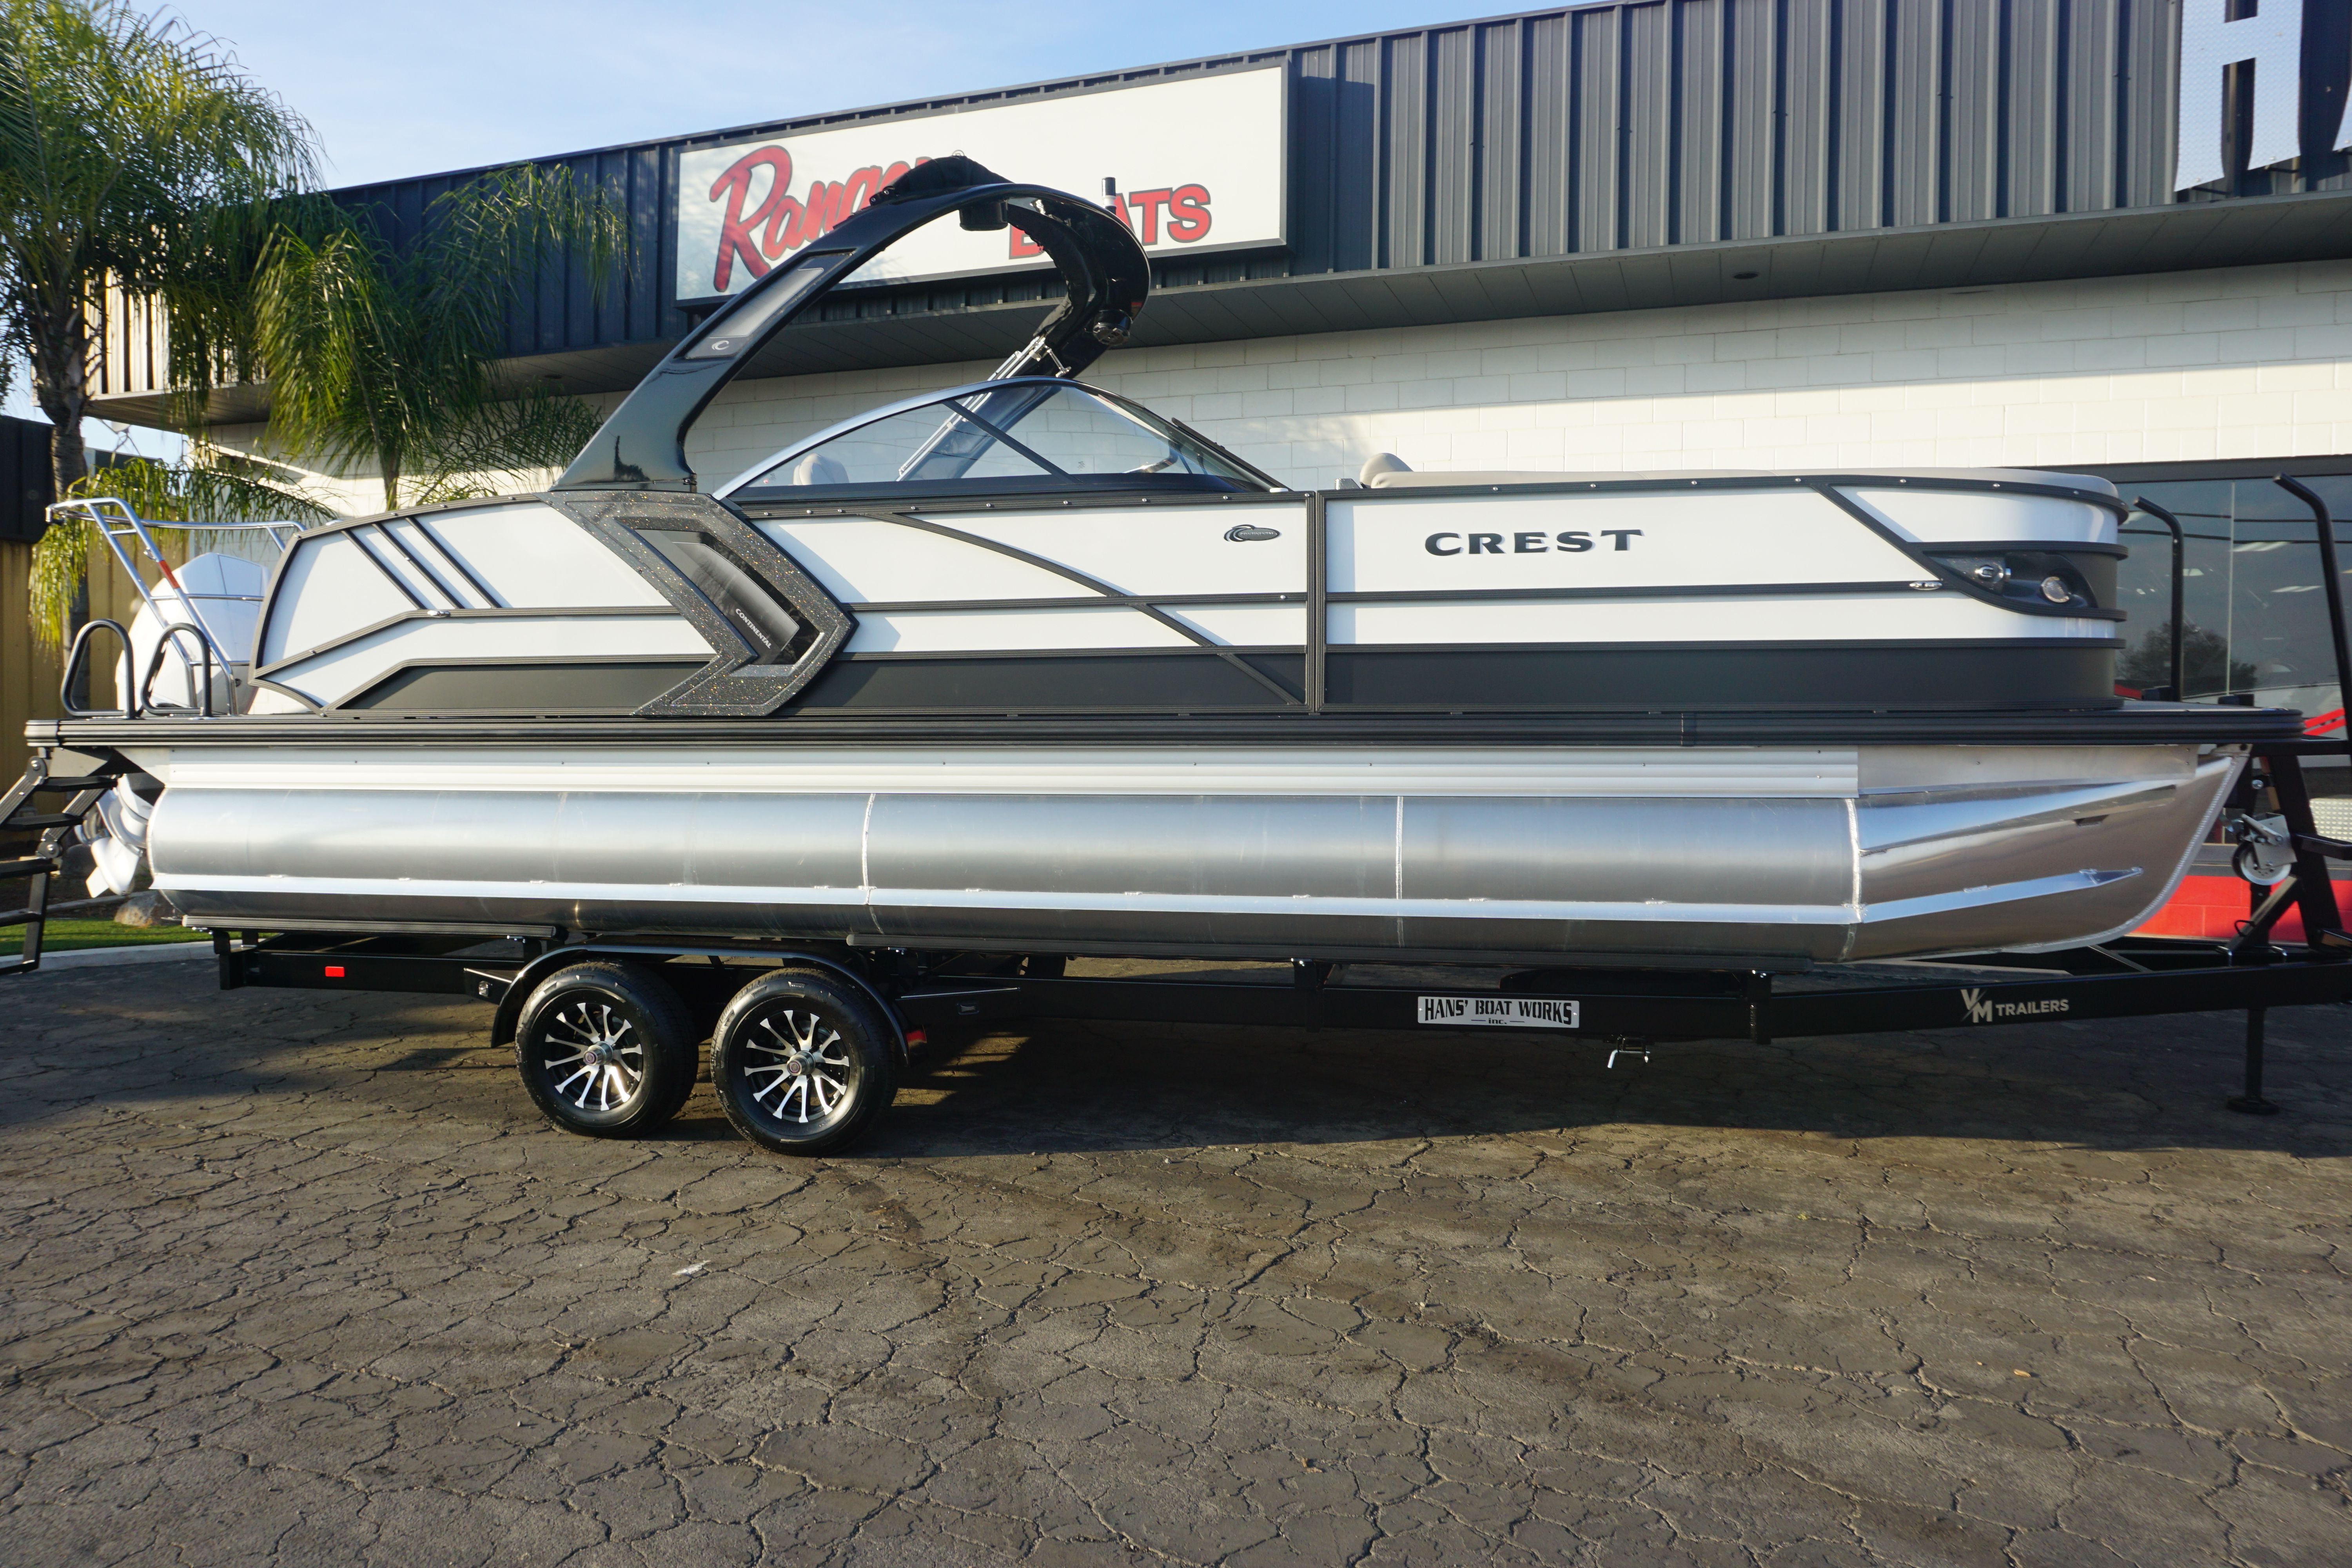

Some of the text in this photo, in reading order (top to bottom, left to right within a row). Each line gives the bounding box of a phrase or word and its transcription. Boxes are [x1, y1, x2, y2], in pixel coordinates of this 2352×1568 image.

[1425, 529, 1644, 556] CREST
[735, 608, 771, 649] CONTINENTAL
[1425, 998, 1572, 1025] HANS' BOAT WORKS
[1995, 999, 2070, 1016] TRAILERS
